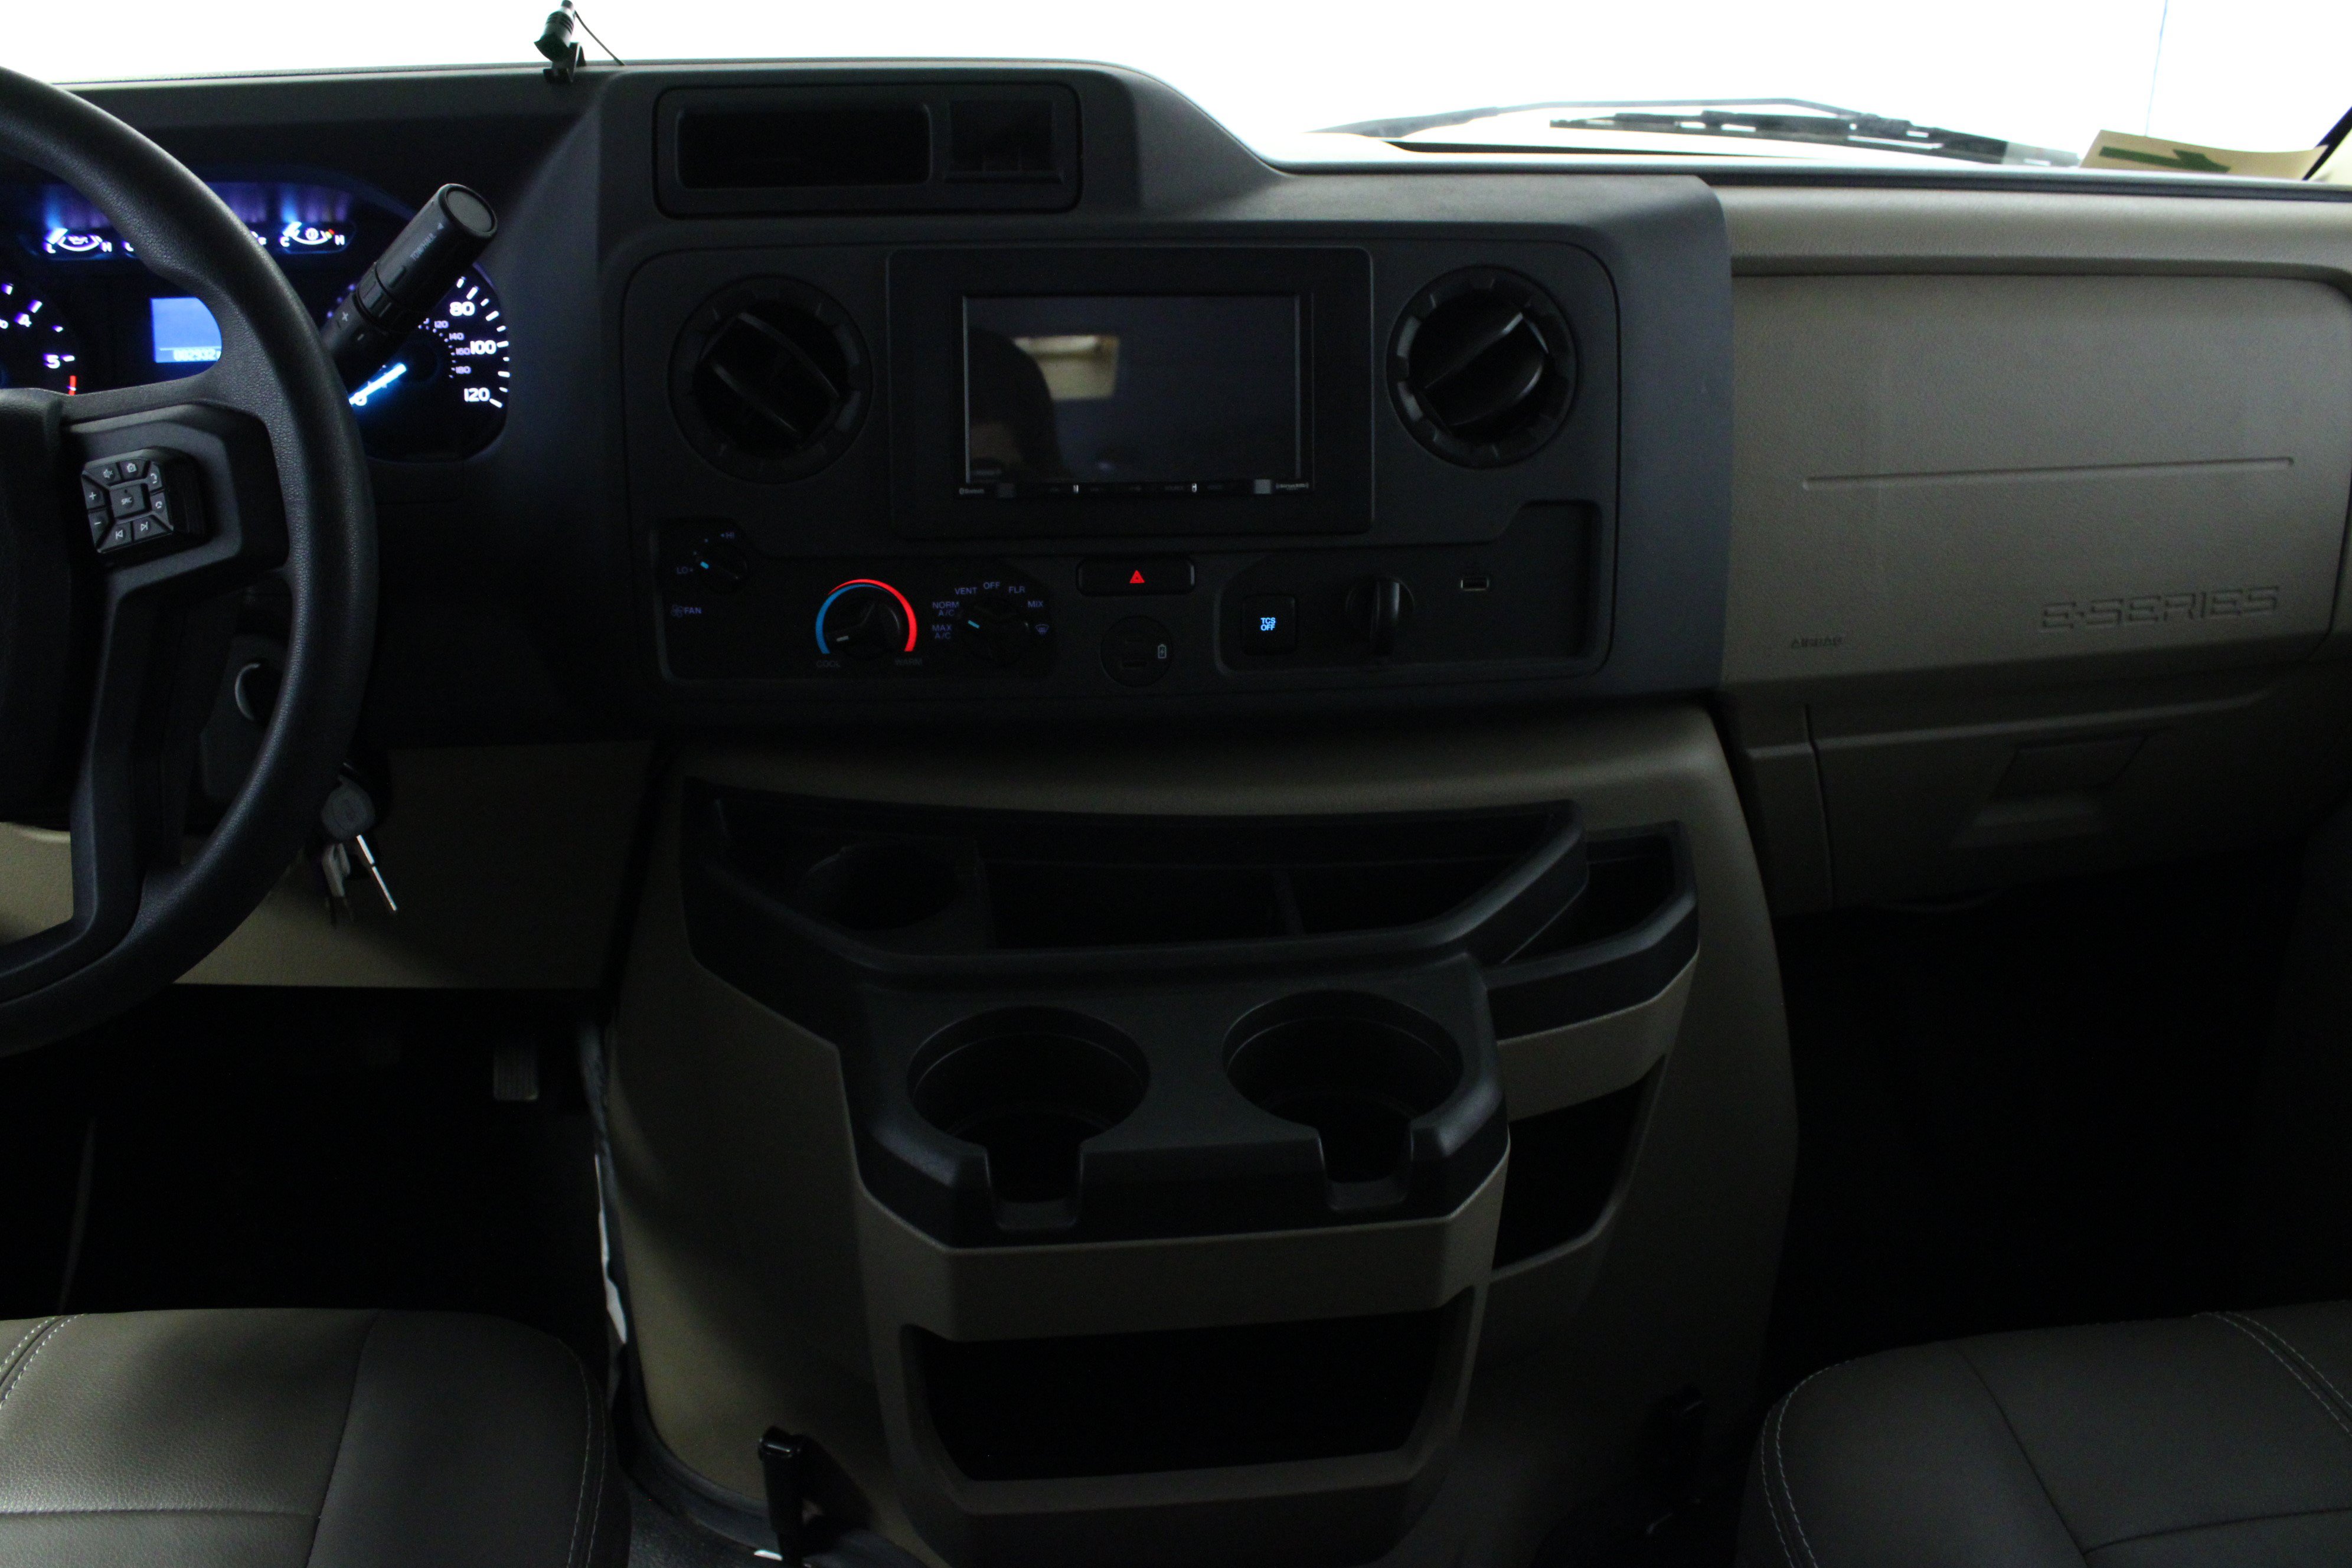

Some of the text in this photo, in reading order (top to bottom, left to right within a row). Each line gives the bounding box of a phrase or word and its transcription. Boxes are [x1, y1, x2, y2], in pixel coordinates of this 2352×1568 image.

[334, 235, 345, 246] H
[100, 241, 112, 252] H
[449, 301, 475, 316] 80
[16, 313, 32, 328] 4
[434, 320, 449, 329] 120
[449, 332, 465, 341] 140
[455, 347, 471, 355] 160
[470, 339, 496, 355] 100
[44, 354, 60, 368] 5
[463, 387, 490, 402] 120
[676, 566, 688, 574] LO
[983, 581, 1001, 590] OFF
[1008, 586, 1026, 594] FLR
[954, 587, 978, 595] VENT
[932, 600, 960, 609] NORM
[1027, 600, 1044, 609] MIX
[932, 623, 953, 632] MAX
[935, 632, 952, 640] A/C
[895, 657, 922, 667] WARM
